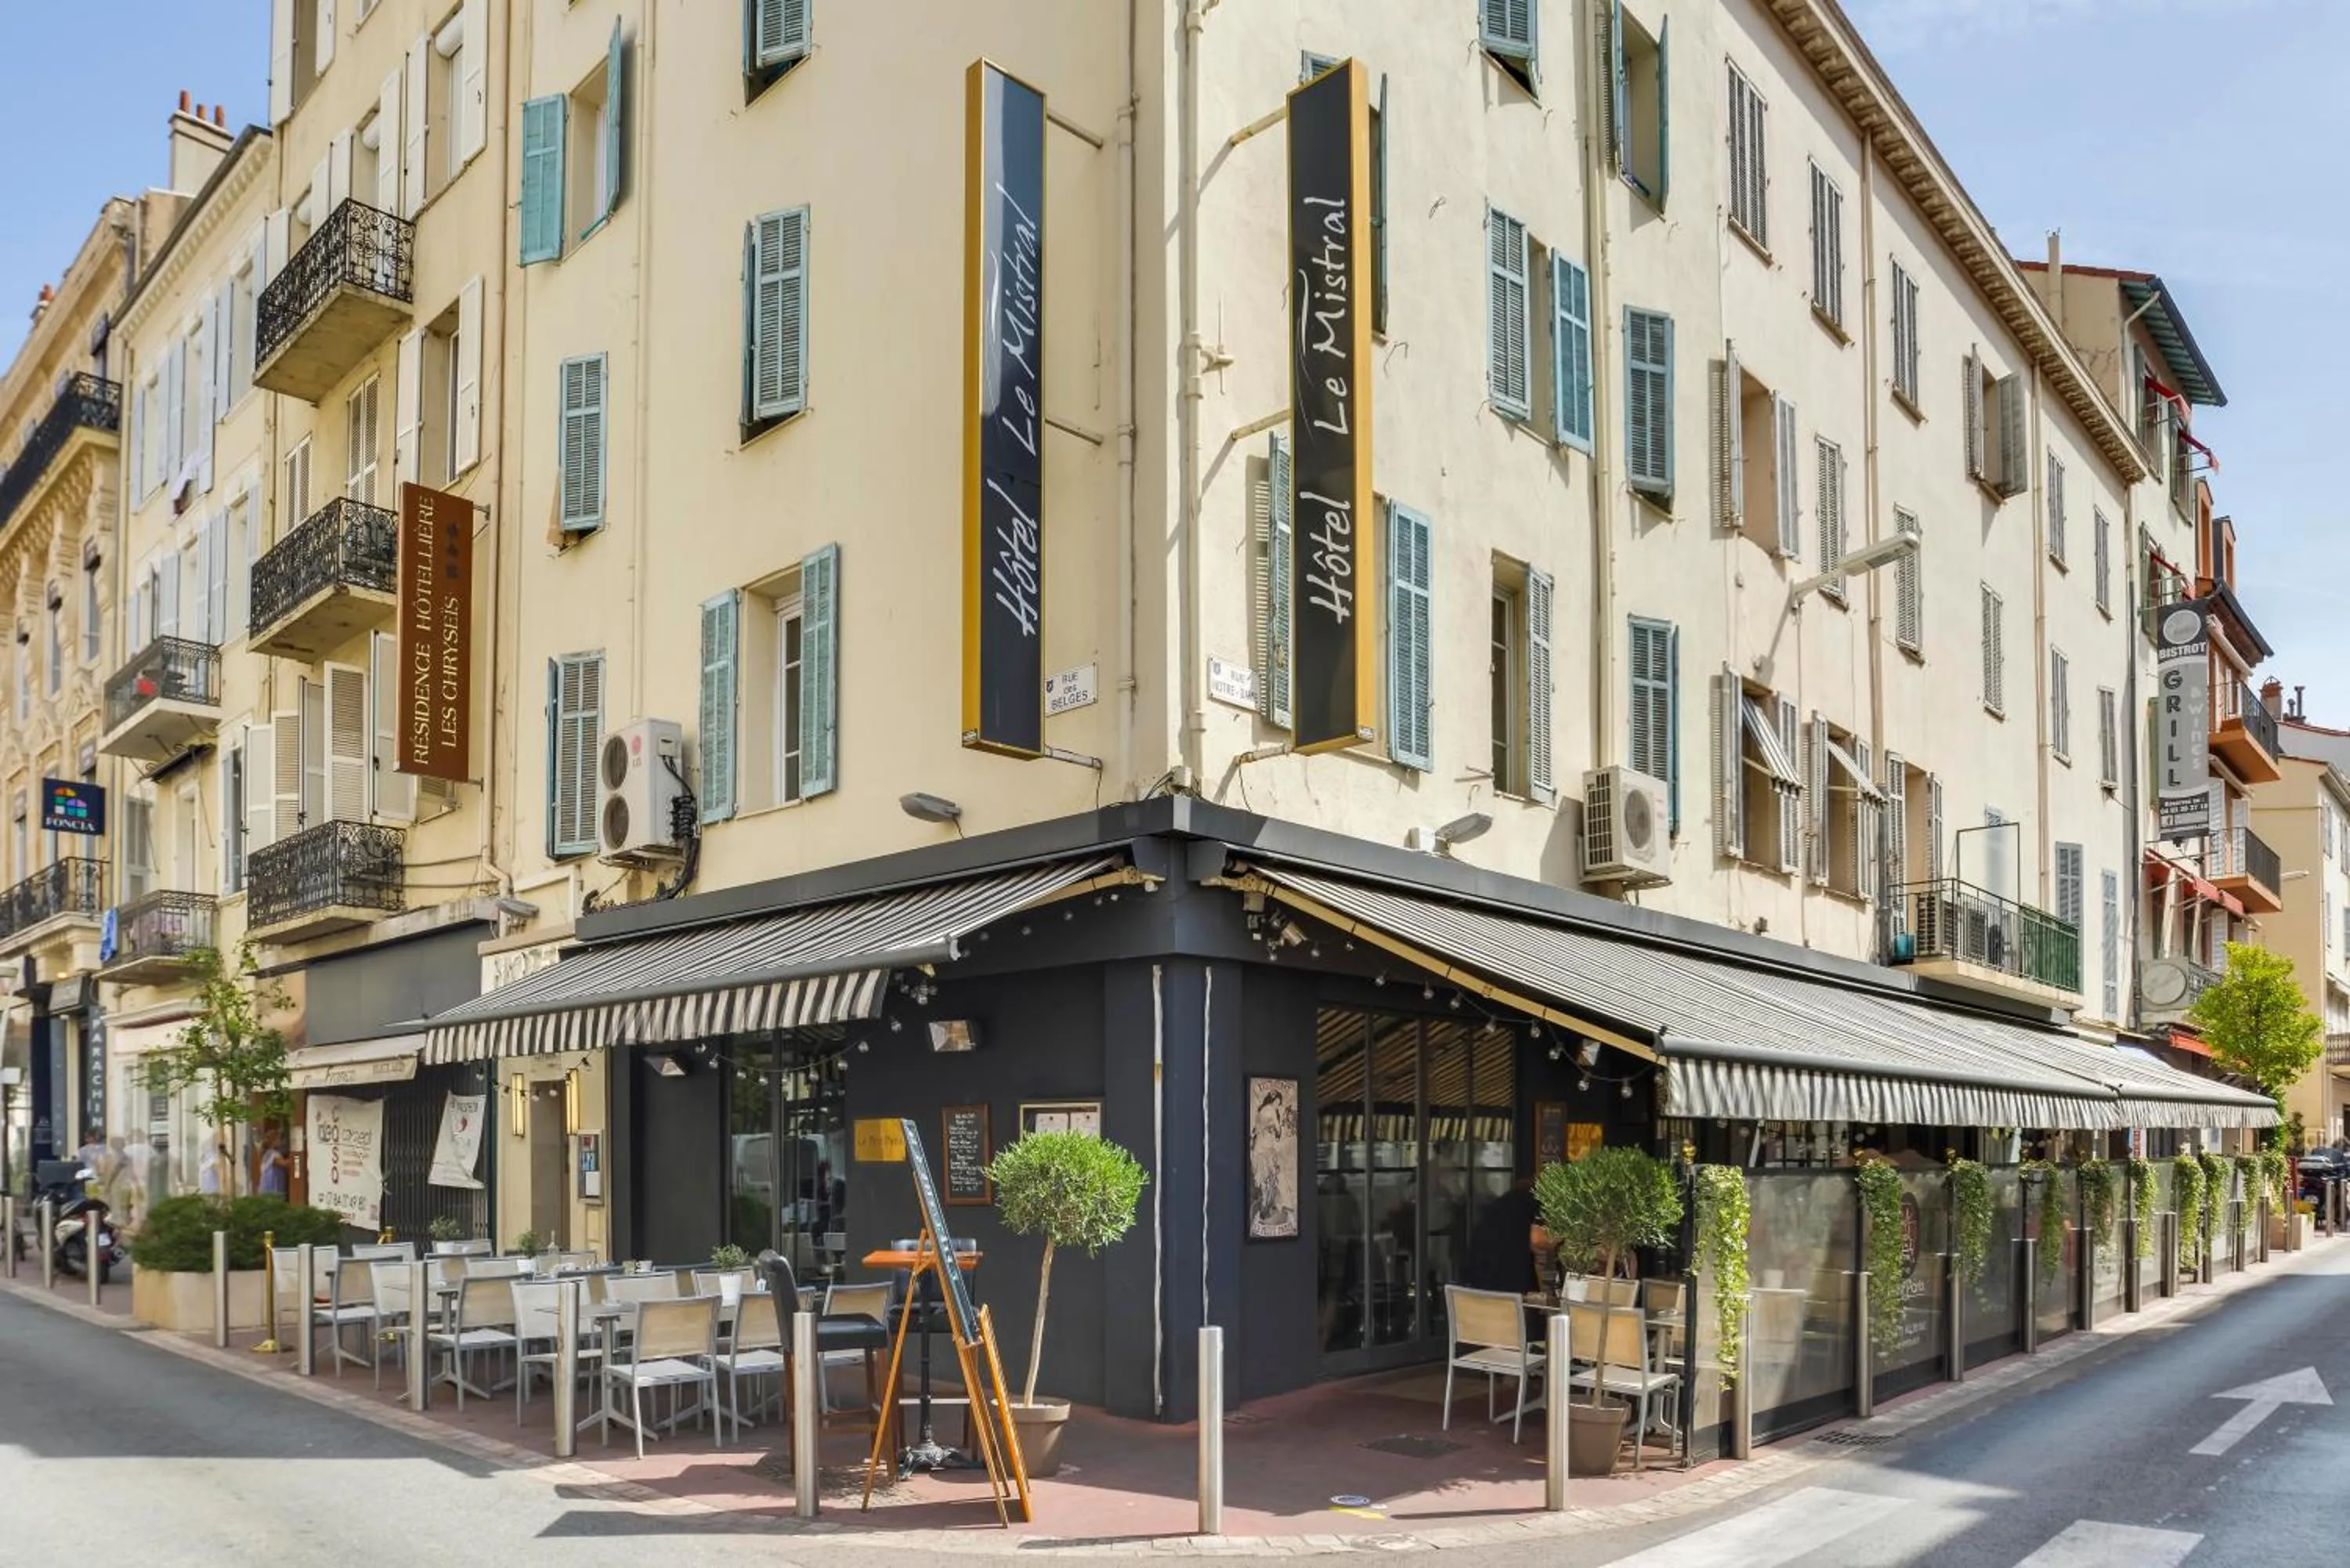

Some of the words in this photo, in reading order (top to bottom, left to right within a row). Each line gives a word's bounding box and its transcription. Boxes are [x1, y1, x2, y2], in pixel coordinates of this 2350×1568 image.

[995, 181, 1037, 380] Mistral
[1303, 197, 1347, 359] Mistral
[1001, 385, 1037, 457] Le
[1313, 376, 1349, 435] Le
[414, 496, 435, 630] HÔTELLIÈRE
[985, 477, 1038, 637] Hôtel
[1299, 490, 1353, 624] Hôtel
[1061, 671, 1079, 684] RUE
[2159, 641, 2207, 659] BISTROT
[410, 643, 431, 766] RÉSIDENCE
[441, 705, 457, 749] LES
[1050, 689, 1090, 710] BELGES
[2163, 670, 2183, 787] GRILL
[45, 817, 95, 832] FONCIA
